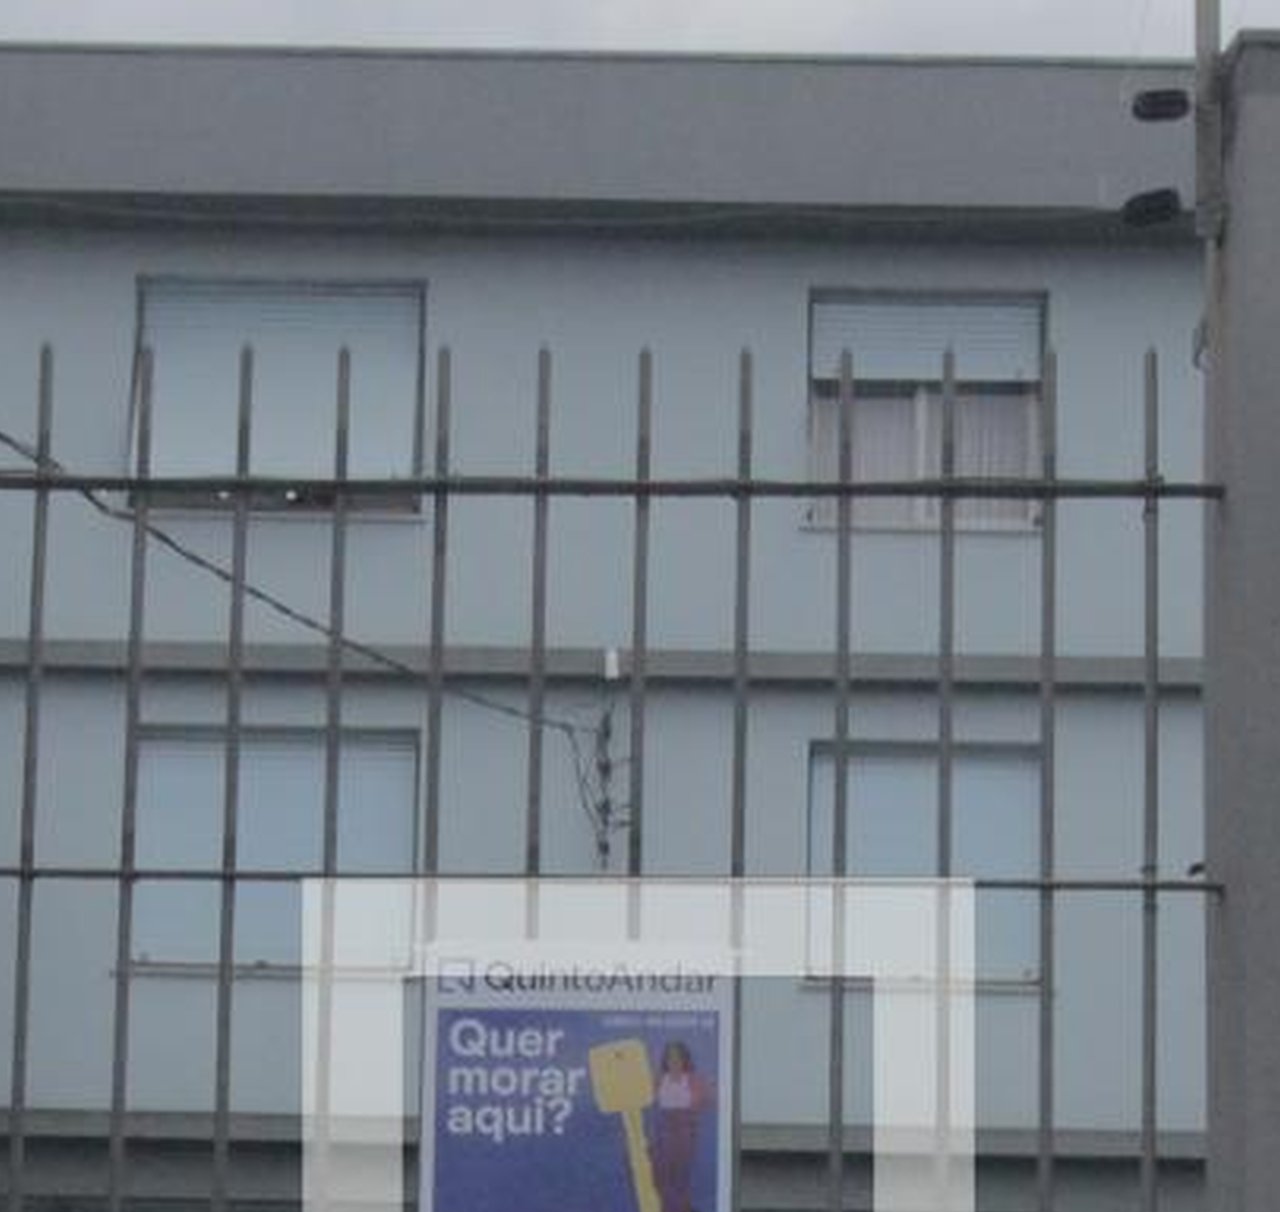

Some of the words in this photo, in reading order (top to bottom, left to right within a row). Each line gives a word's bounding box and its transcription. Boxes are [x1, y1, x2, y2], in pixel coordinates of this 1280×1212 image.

[484, 961, 718, 994] QuintoAndar
[449, 1018, 565, 1058] Quer
[447, 1065, 587, 1097] morar
[446, 1096, 573, 1143] aqui?
